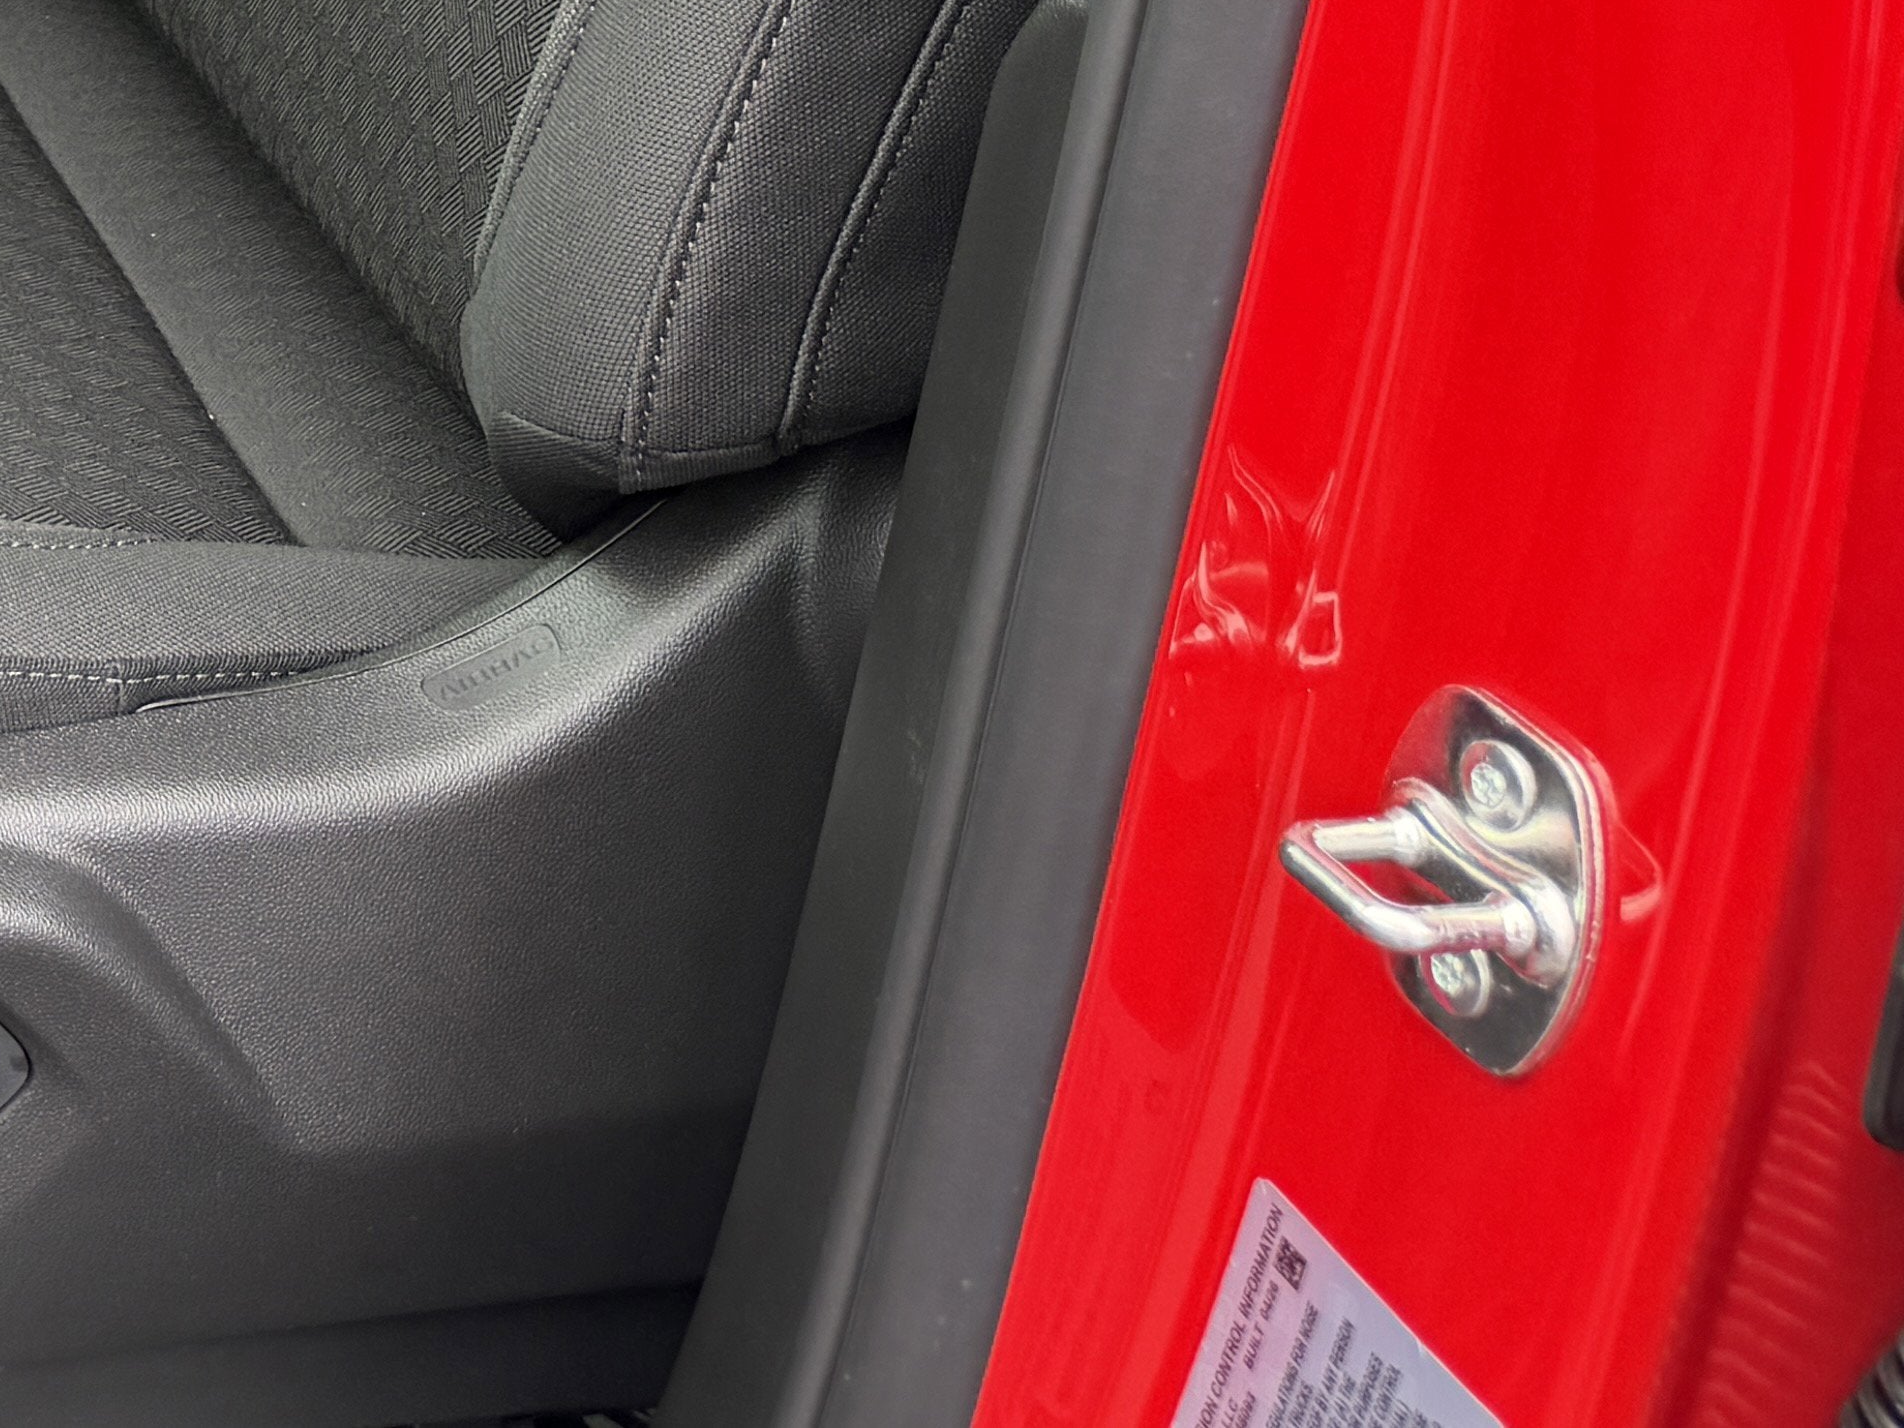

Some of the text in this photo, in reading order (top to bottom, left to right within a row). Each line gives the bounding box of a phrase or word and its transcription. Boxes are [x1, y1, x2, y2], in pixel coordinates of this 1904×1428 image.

[1210, 1317, 1246, 1398] CONTROL
[1239, 1203, 1283, 1318] INFORMATION
[1243, 1322, 1265, 1371] BUILT
[1290, 1336, 1306, 1365] FOR
[1330, 1317, 1354, 1369] PERSON
